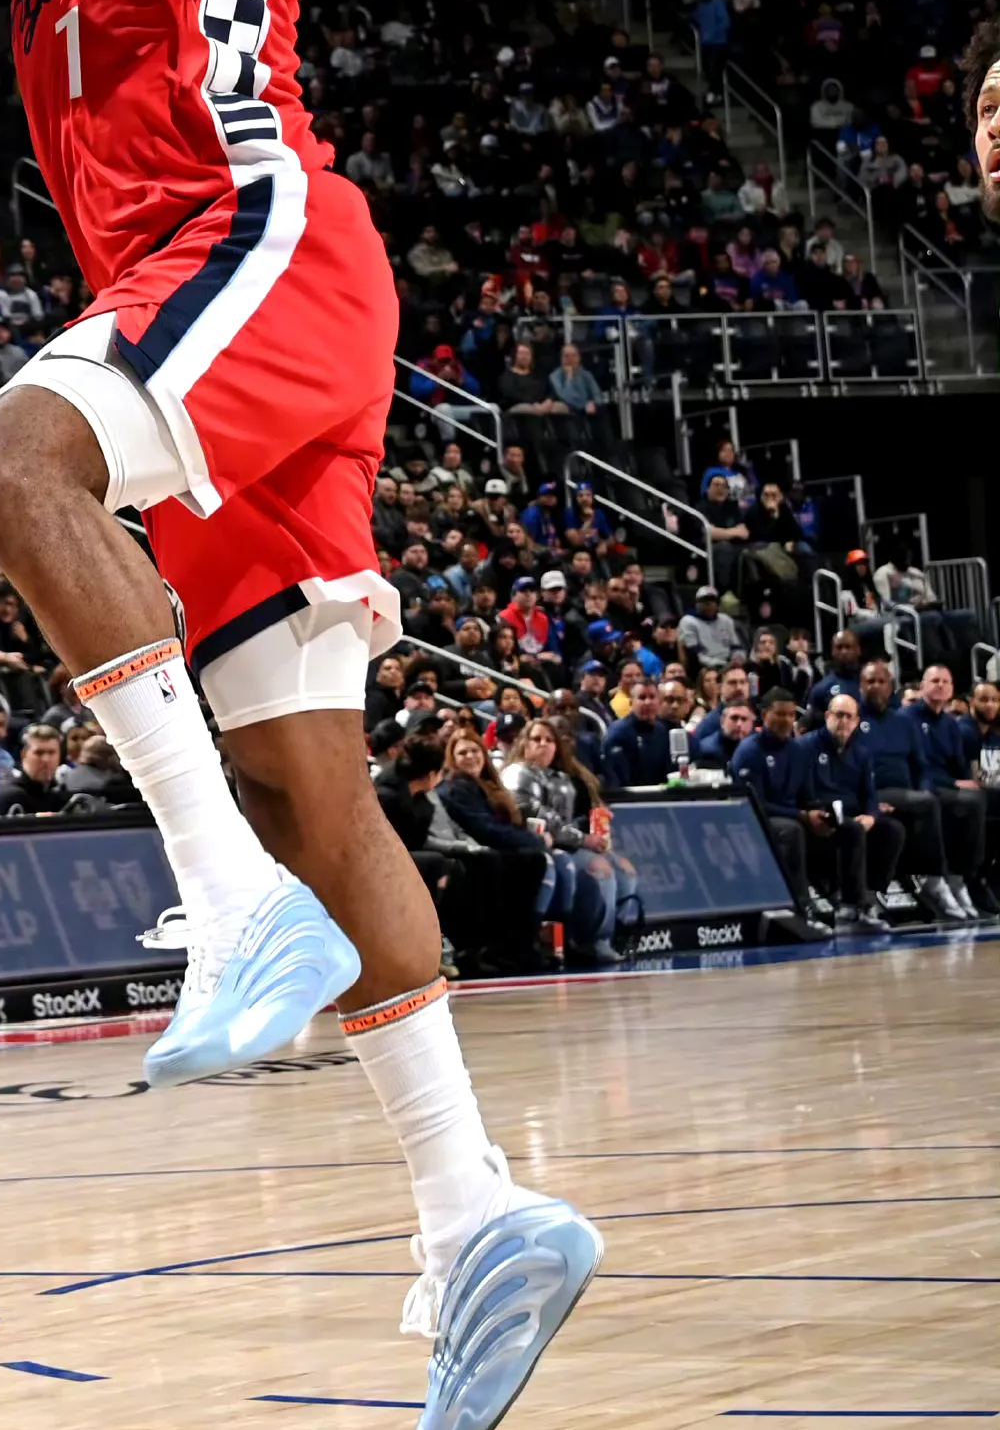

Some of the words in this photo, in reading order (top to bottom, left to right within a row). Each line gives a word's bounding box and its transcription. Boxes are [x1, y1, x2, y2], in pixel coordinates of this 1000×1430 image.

[55, 5, 83, 100] 1
[697, 923, 743, 947] StockX
[32, 987, 102, 1017] StockX
